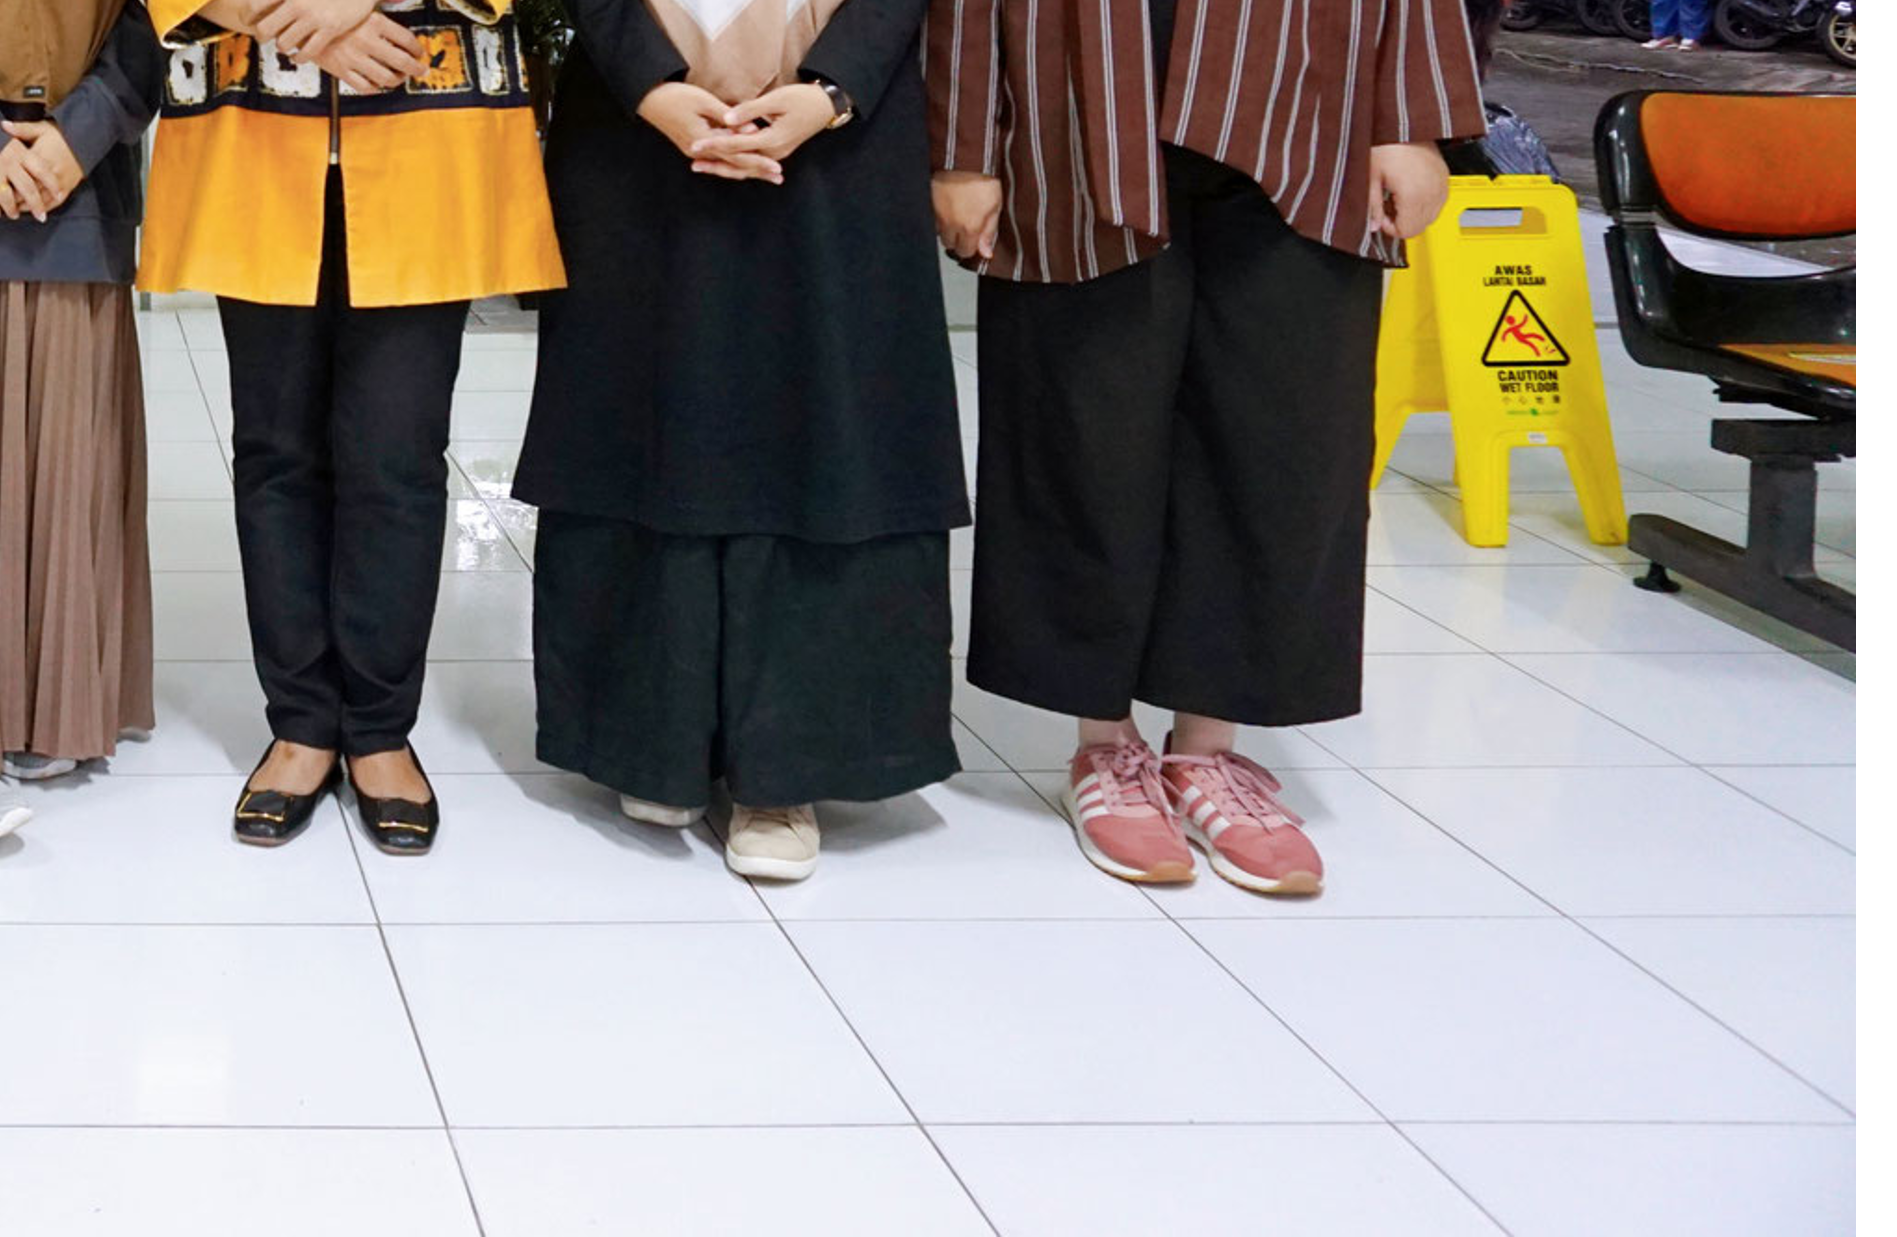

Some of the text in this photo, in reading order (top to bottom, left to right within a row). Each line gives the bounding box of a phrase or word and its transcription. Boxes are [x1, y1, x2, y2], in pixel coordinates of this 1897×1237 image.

[1495, 265, 1533, 275] AWAS
[1497, 369, 1558, 382] CAUTION
[1499, 382, 1559, 393] WET FLOOR
